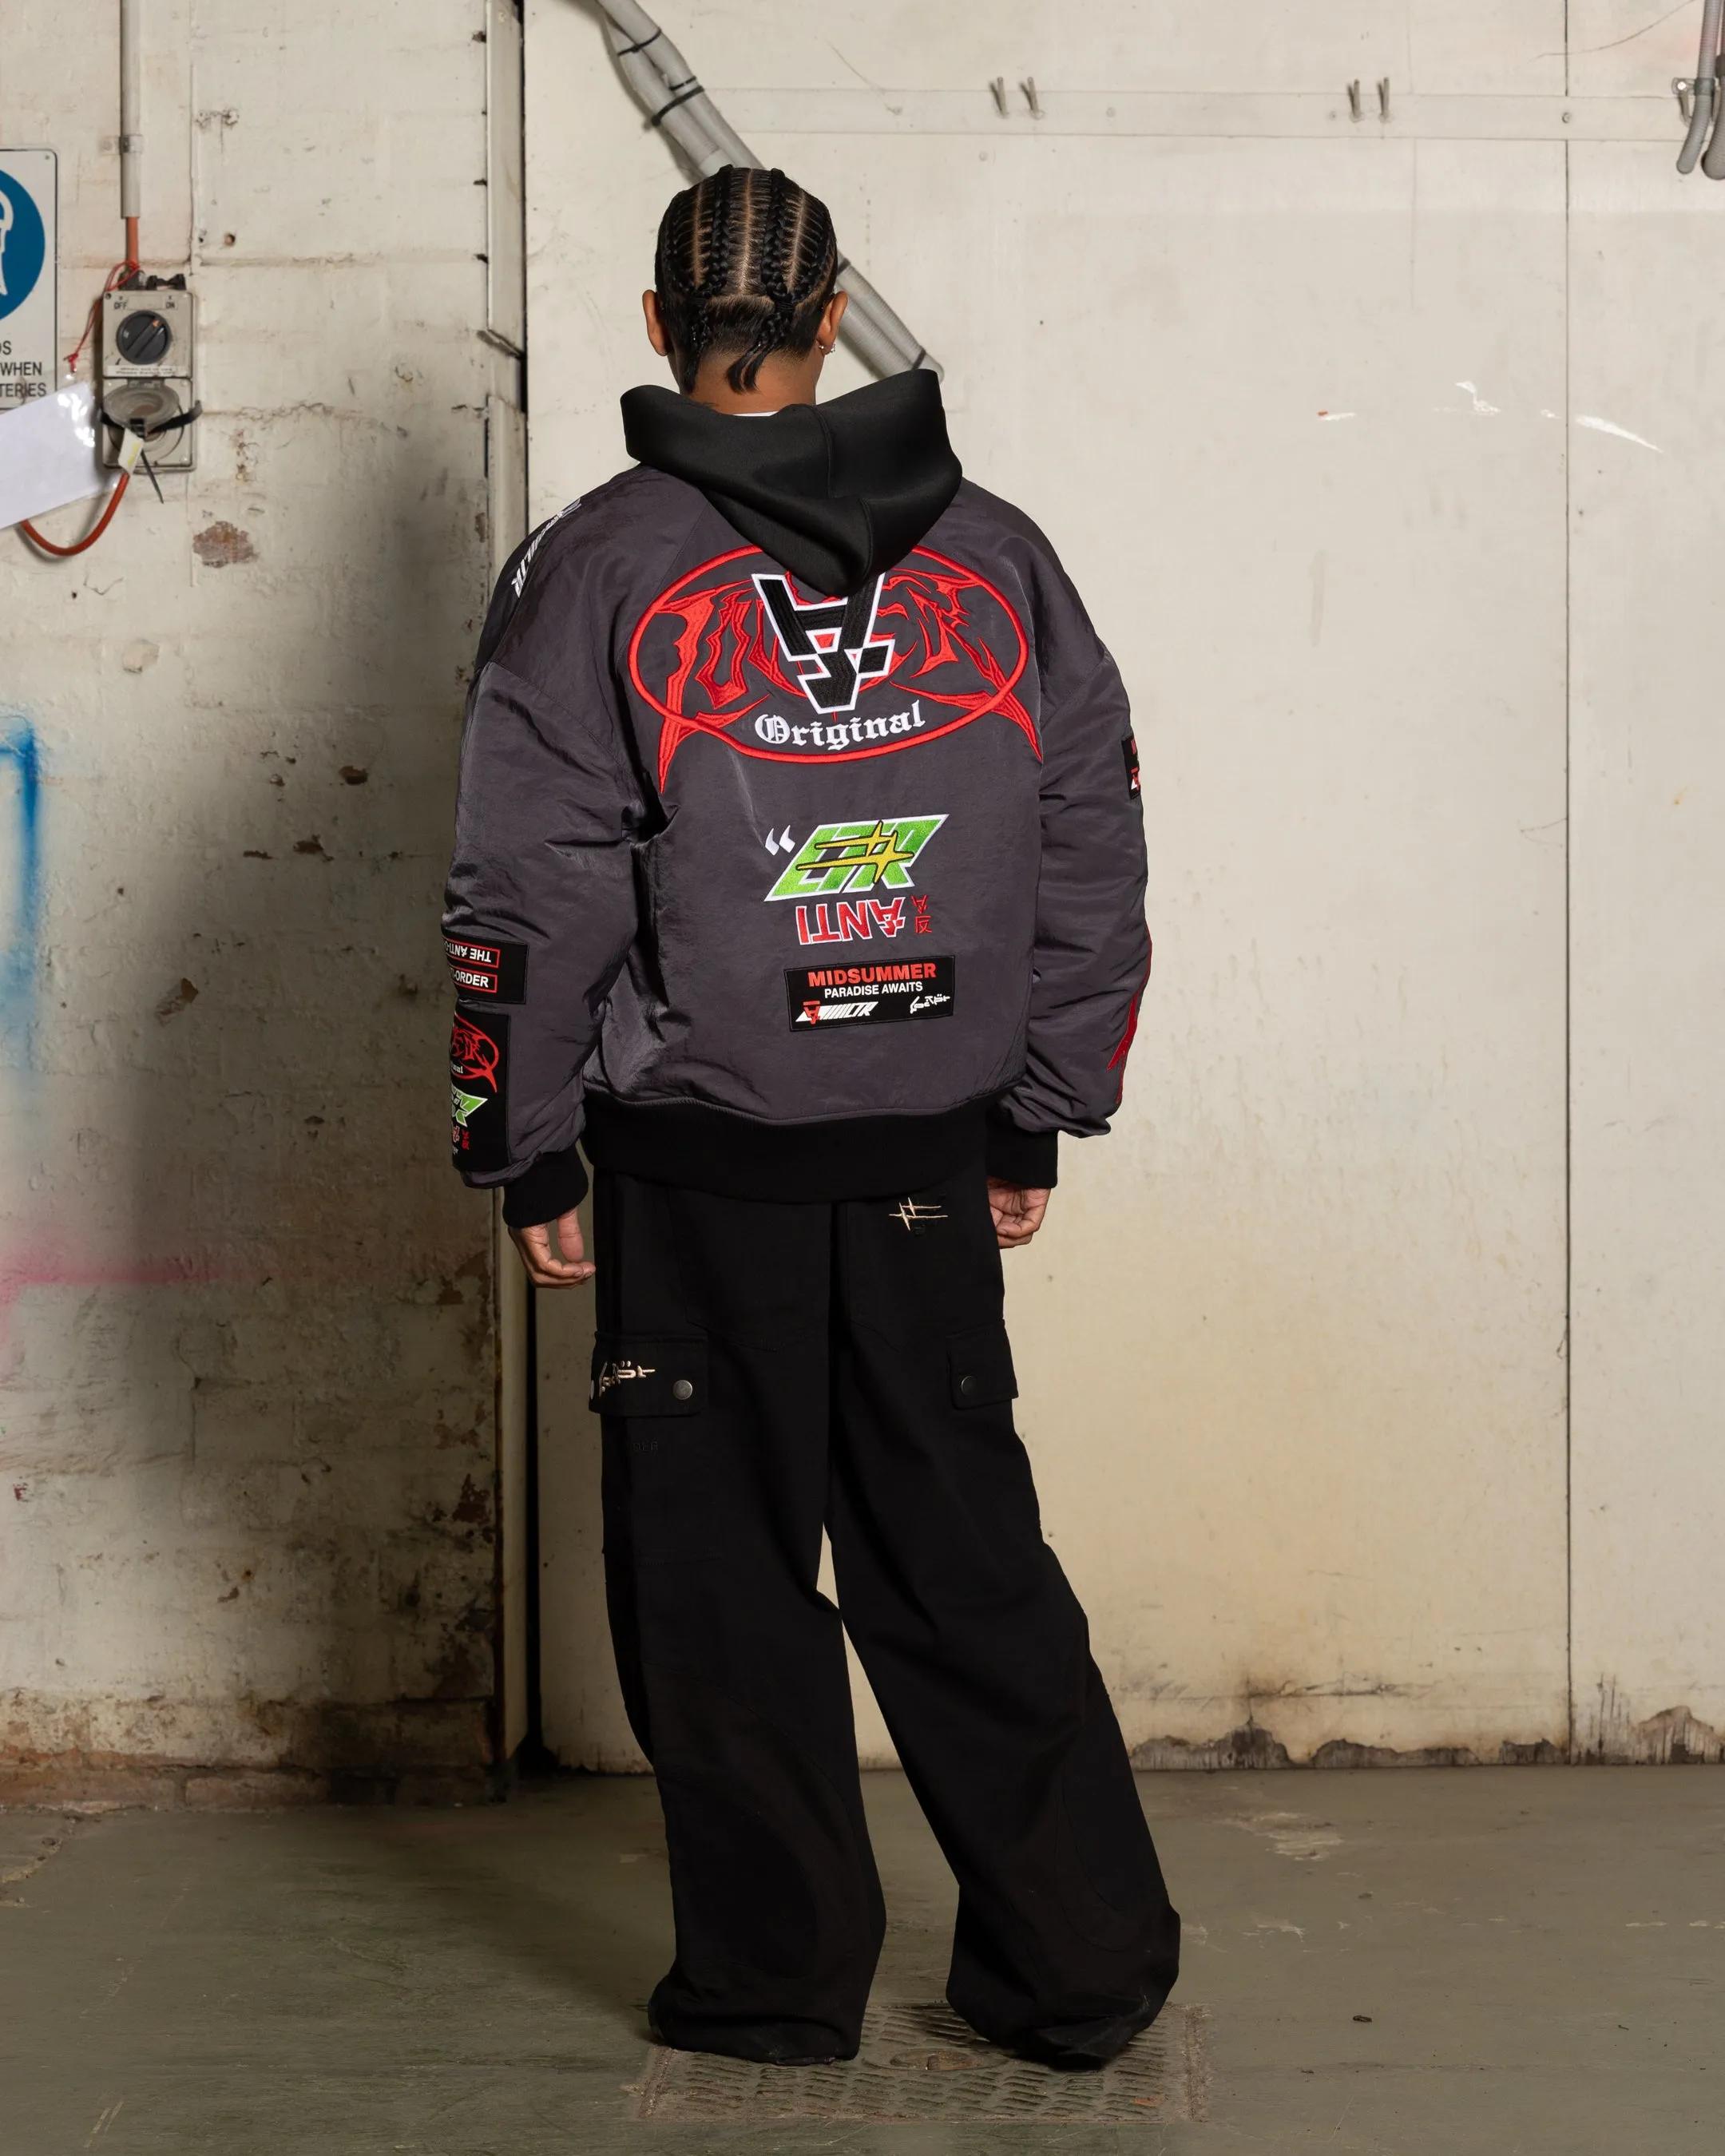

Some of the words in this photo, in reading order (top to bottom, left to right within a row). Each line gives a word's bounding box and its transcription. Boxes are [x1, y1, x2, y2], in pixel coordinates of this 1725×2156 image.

[0, 361, 42, 376] WHEN
[754, 700, 926, 751] Original
[469, 948, 492, 963] THE
[807, 962, 937, 987] MIDSUMMER
[824, 985, 879, 999] PARADISE
[882, 981, 923, 994] AWAITS
